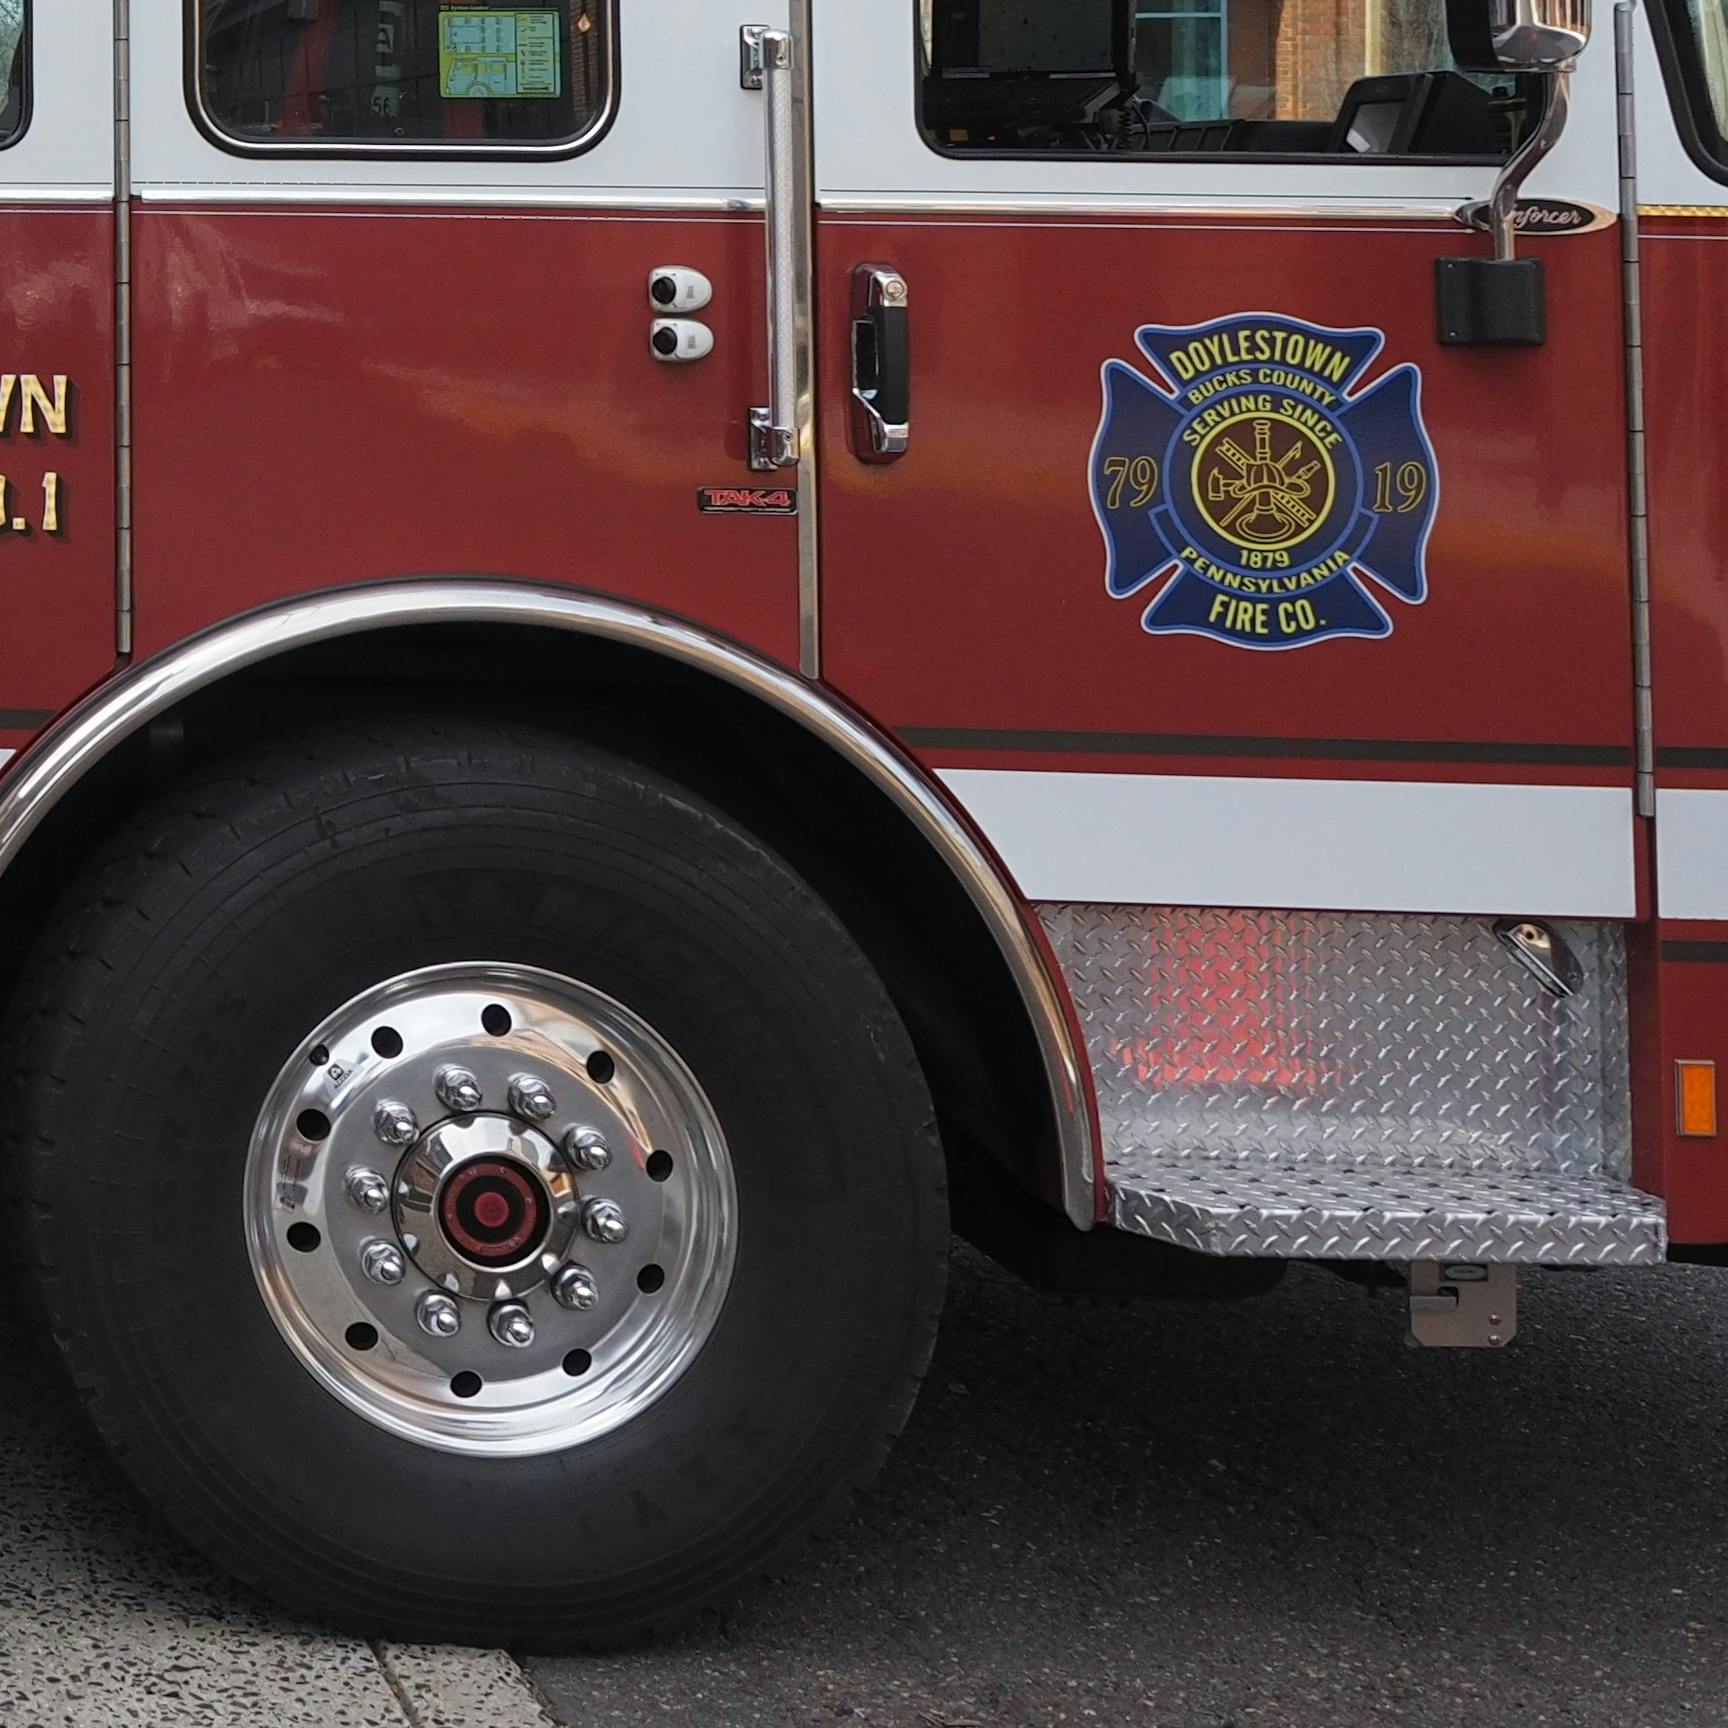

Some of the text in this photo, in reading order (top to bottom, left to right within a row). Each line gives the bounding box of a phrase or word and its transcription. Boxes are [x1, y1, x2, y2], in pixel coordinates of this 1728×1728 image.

[1168, 329, 1351, 382] DOYLESTOWN
[1187, 368, 1336, 407] BUCKS COUNTY
[1182, 394, 1343, 448] SERVING SINCE
[42, 471, 57, 530] 1
[704, 490, 791, 506] TAK-4
[1104, 456, 1158, 509] 79
[1373, 461, 1426, 513] 19
[1179, 546, 1351, 593] PENNSYLVANIA
[1239, 550, 1291, 568] 1879
[1208, 594, 1326, 634] FIRE CO.
